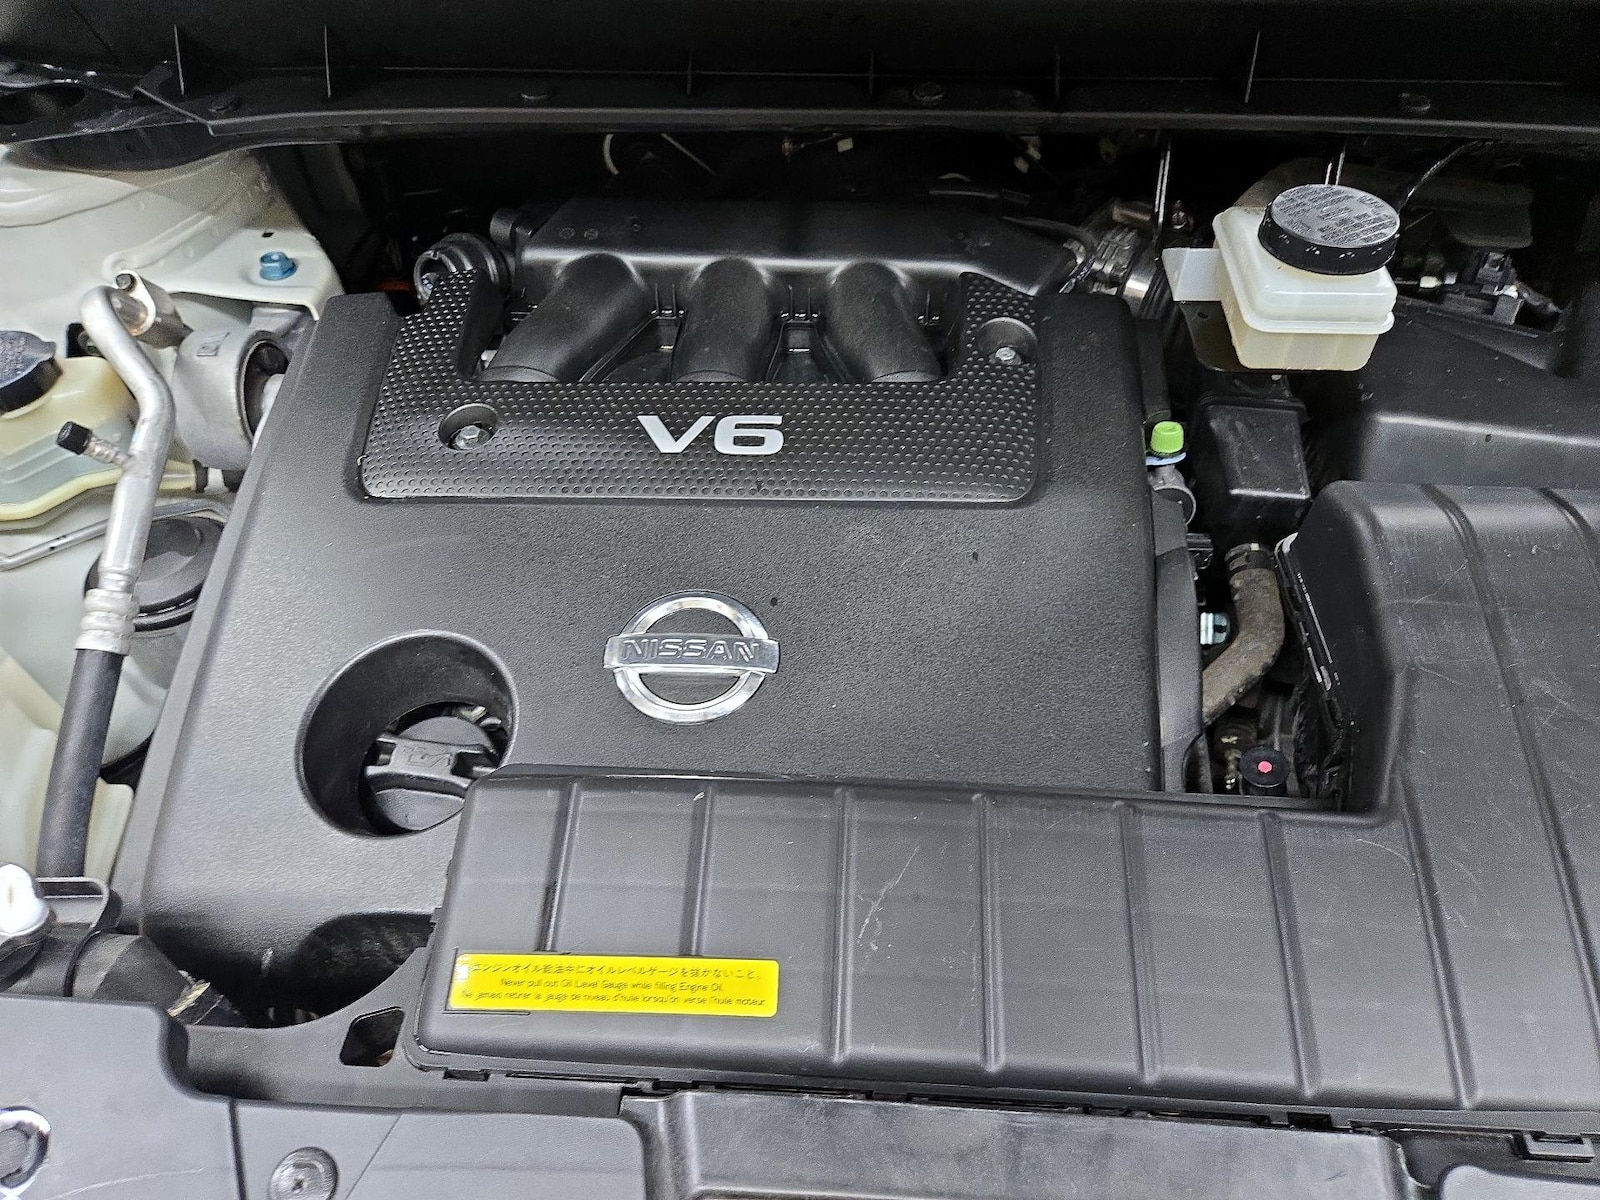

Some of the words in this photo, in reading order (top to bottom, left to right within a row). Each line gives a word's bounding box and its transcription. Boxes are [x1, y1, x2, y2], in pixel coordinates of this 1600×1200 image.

[636, 414, 785, 456] V6
[621, 638, 760, 663] NISSAN
[501, 978, 525, 987] Never
[528, 979, 542, 989] pull
[544, 980, 559, 988] out
[575, 980, 598, 989] Level
[602, 980, 628, 991] Gauge
[631, 982, 652, 990] while
[654, 982, 676, 993] filling
[679, 982, 708, 993] Engine
[544, 993, 567, 1003] jauge
[584, 993, 610, 1002] niveau
[684, 996, 707, 1005] verse
